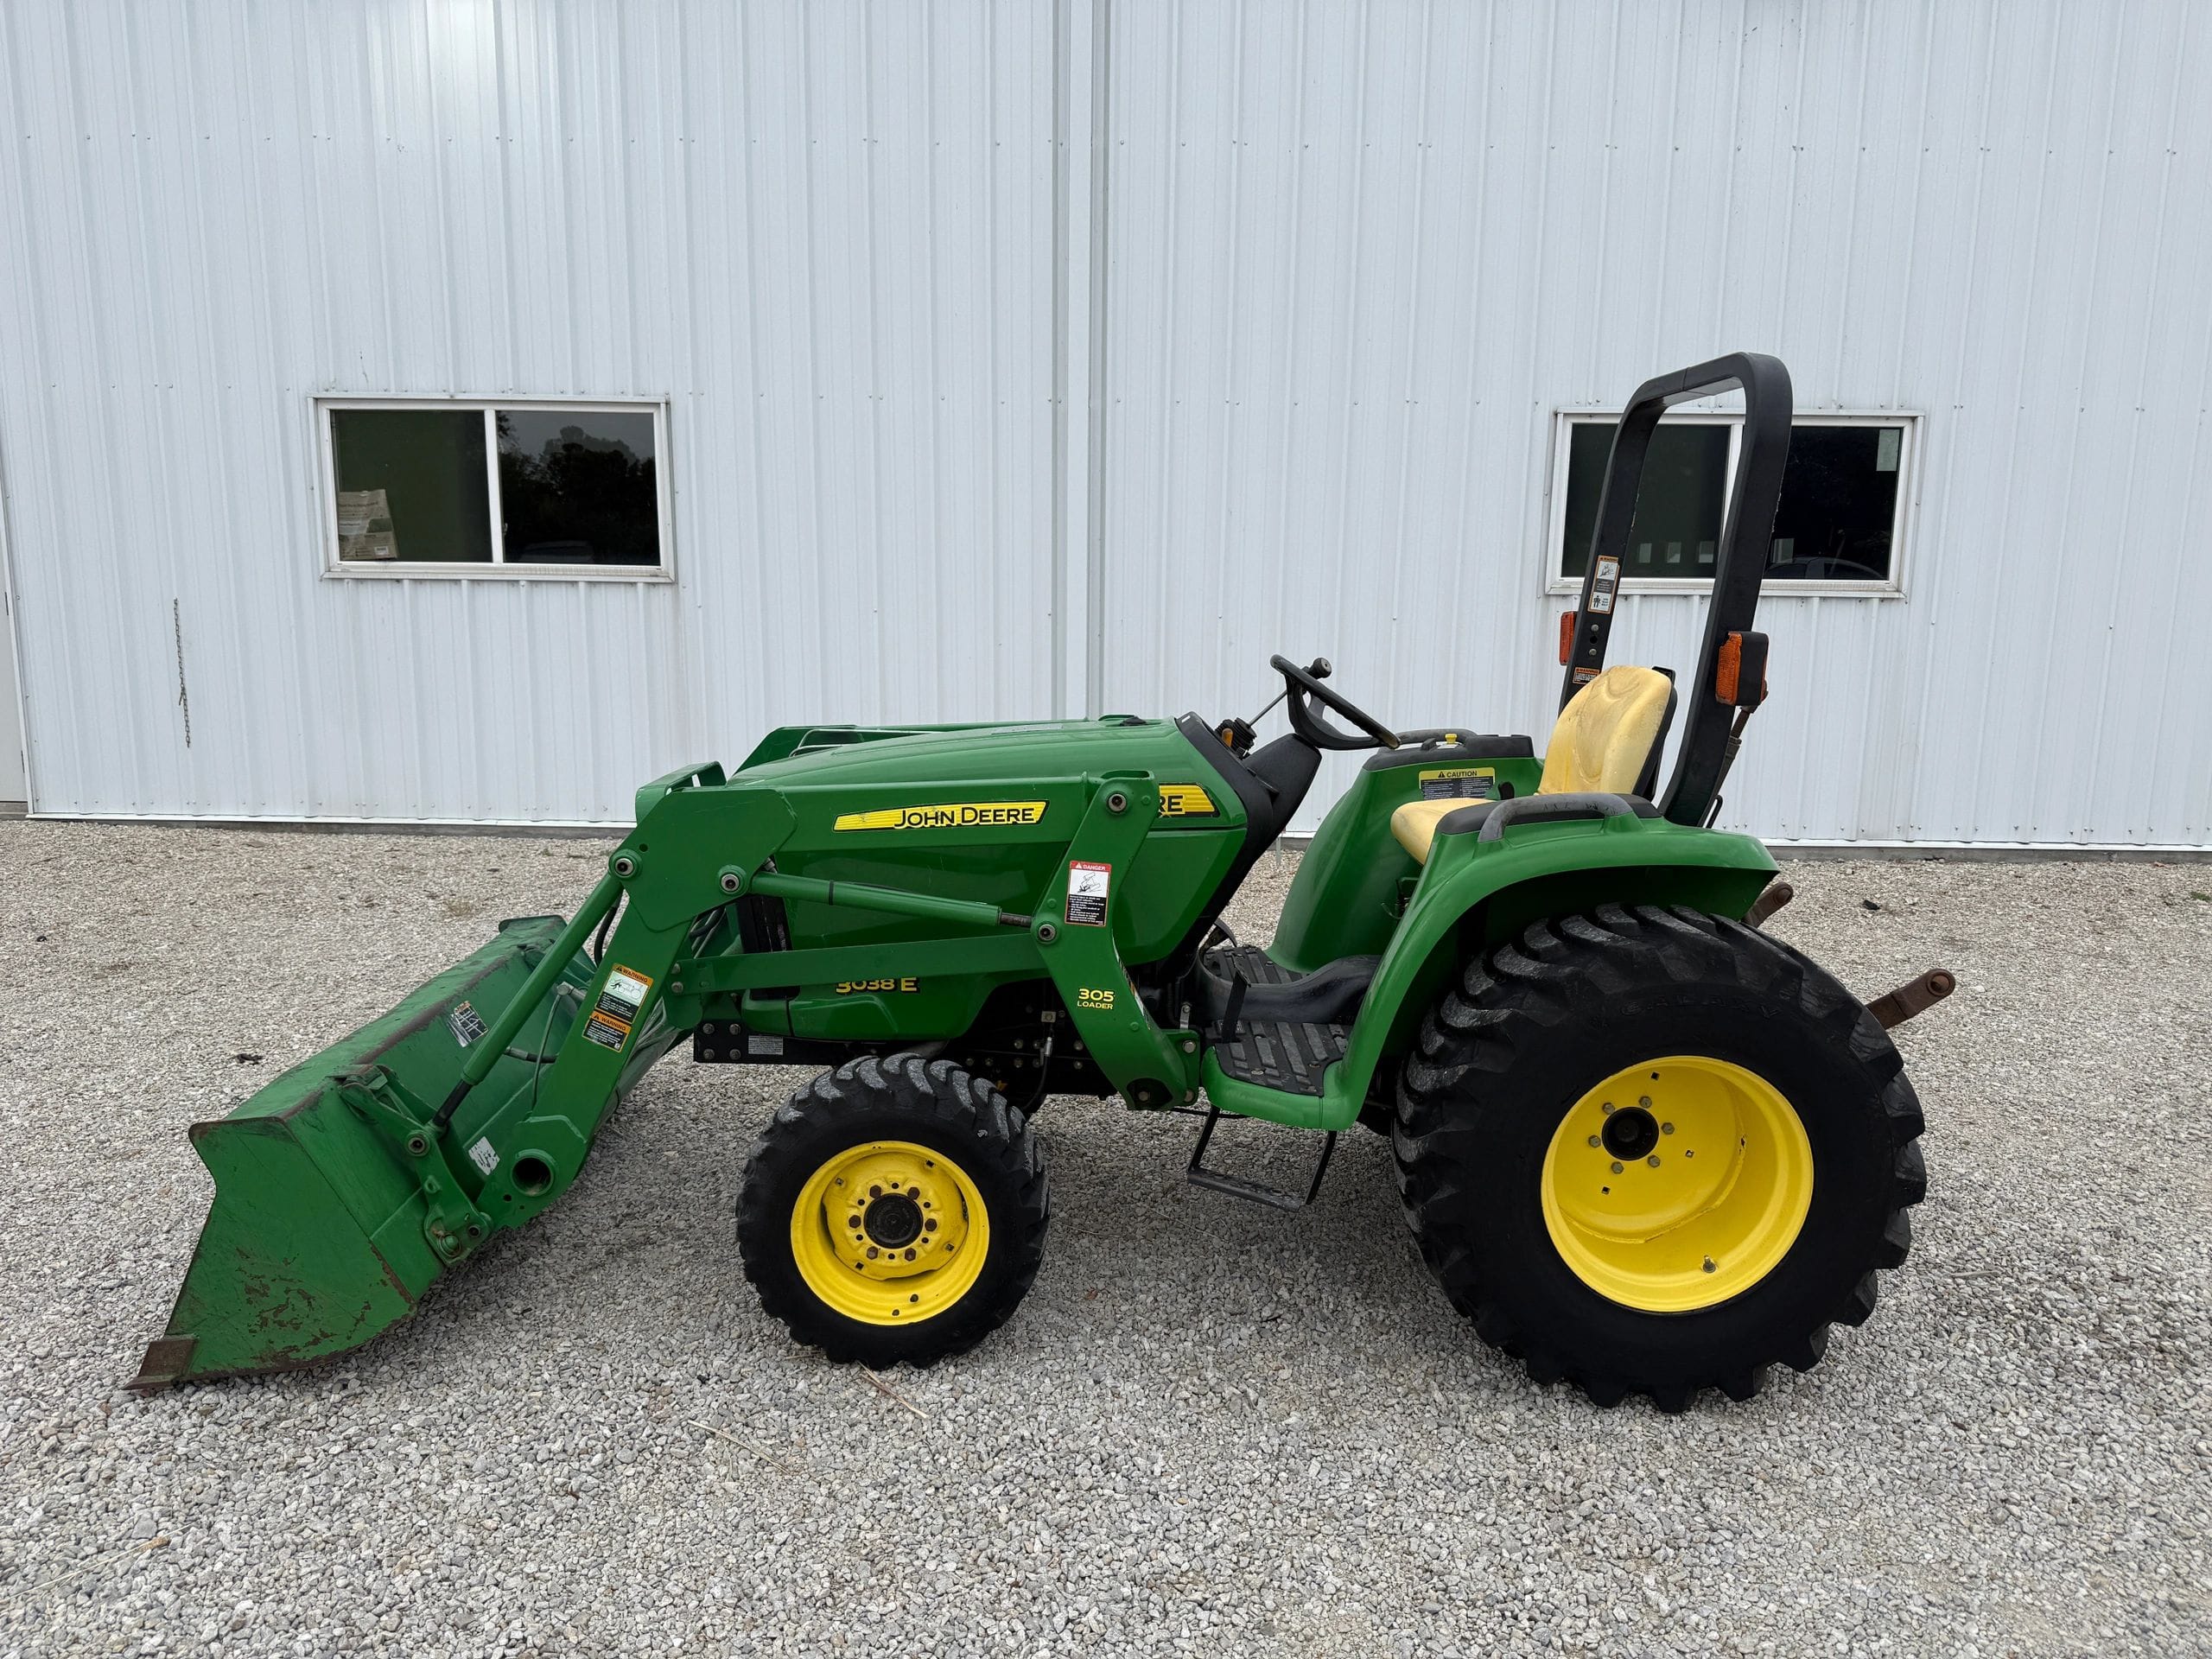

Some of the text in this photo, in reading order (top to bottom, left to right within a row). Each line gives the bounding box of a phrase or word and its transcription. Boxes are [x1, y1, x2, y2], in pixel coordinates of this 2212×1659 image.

[894, 806, 1035, 827] JOHN DEERE
[622, 968, 648, 983] WARNING
[901, 976, 918, 992] E
[1078, 988, 1115, 1002] 305
[1077, 1001, 1114, 1010] LOADER
[601, 1016, 626, 1031] WARNING
